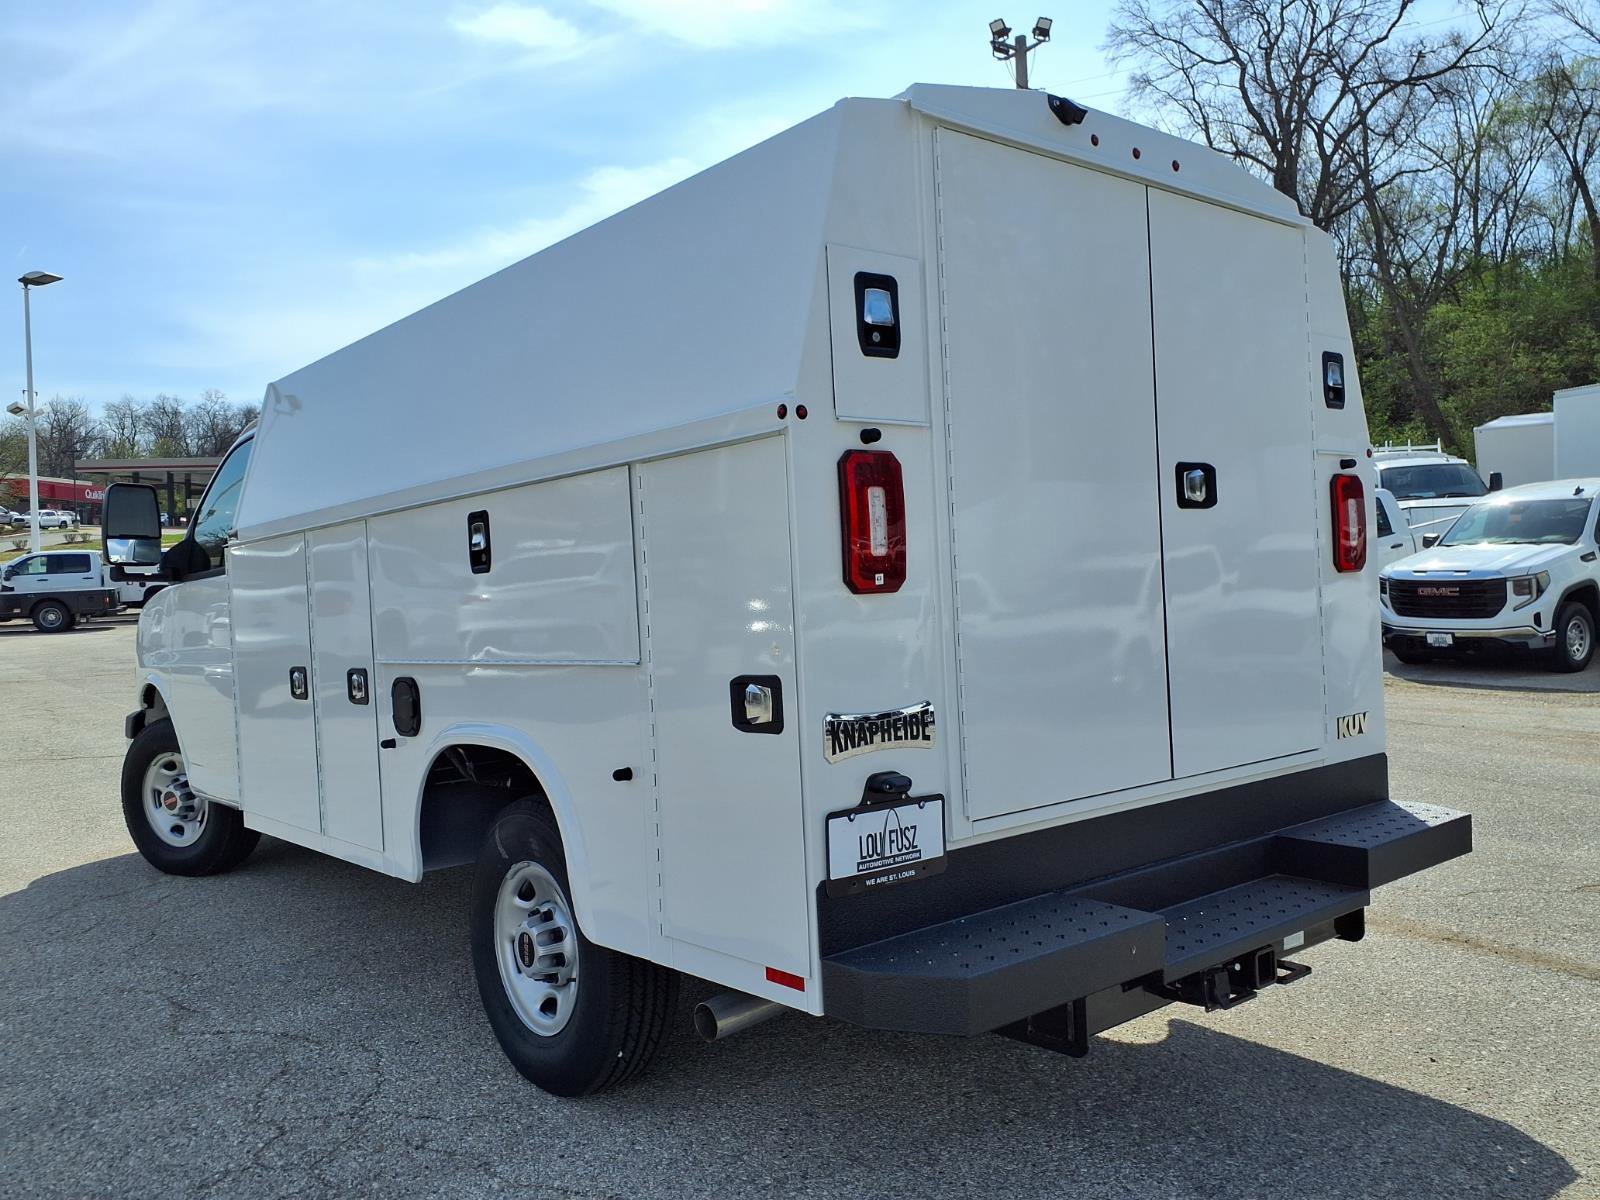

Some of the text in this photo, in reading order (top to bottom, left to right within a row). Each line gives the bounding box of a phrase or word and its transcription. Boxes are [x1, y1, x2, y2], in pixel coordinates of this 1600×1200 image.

[85, 489, 105, 500] QuikTri
[1418, 587, 1459, 597] GMC
[830, 708, 931, 756] KNAPHEIDE
[1337, 711, 1369, 739] KUV
[859, 825, 918, 860] LOU FUSZ
[858, 851, 921, 870] AUTOMOTIVE NETWORK
[866, 869, 916, 886] WE ARE ST. LOUIS
